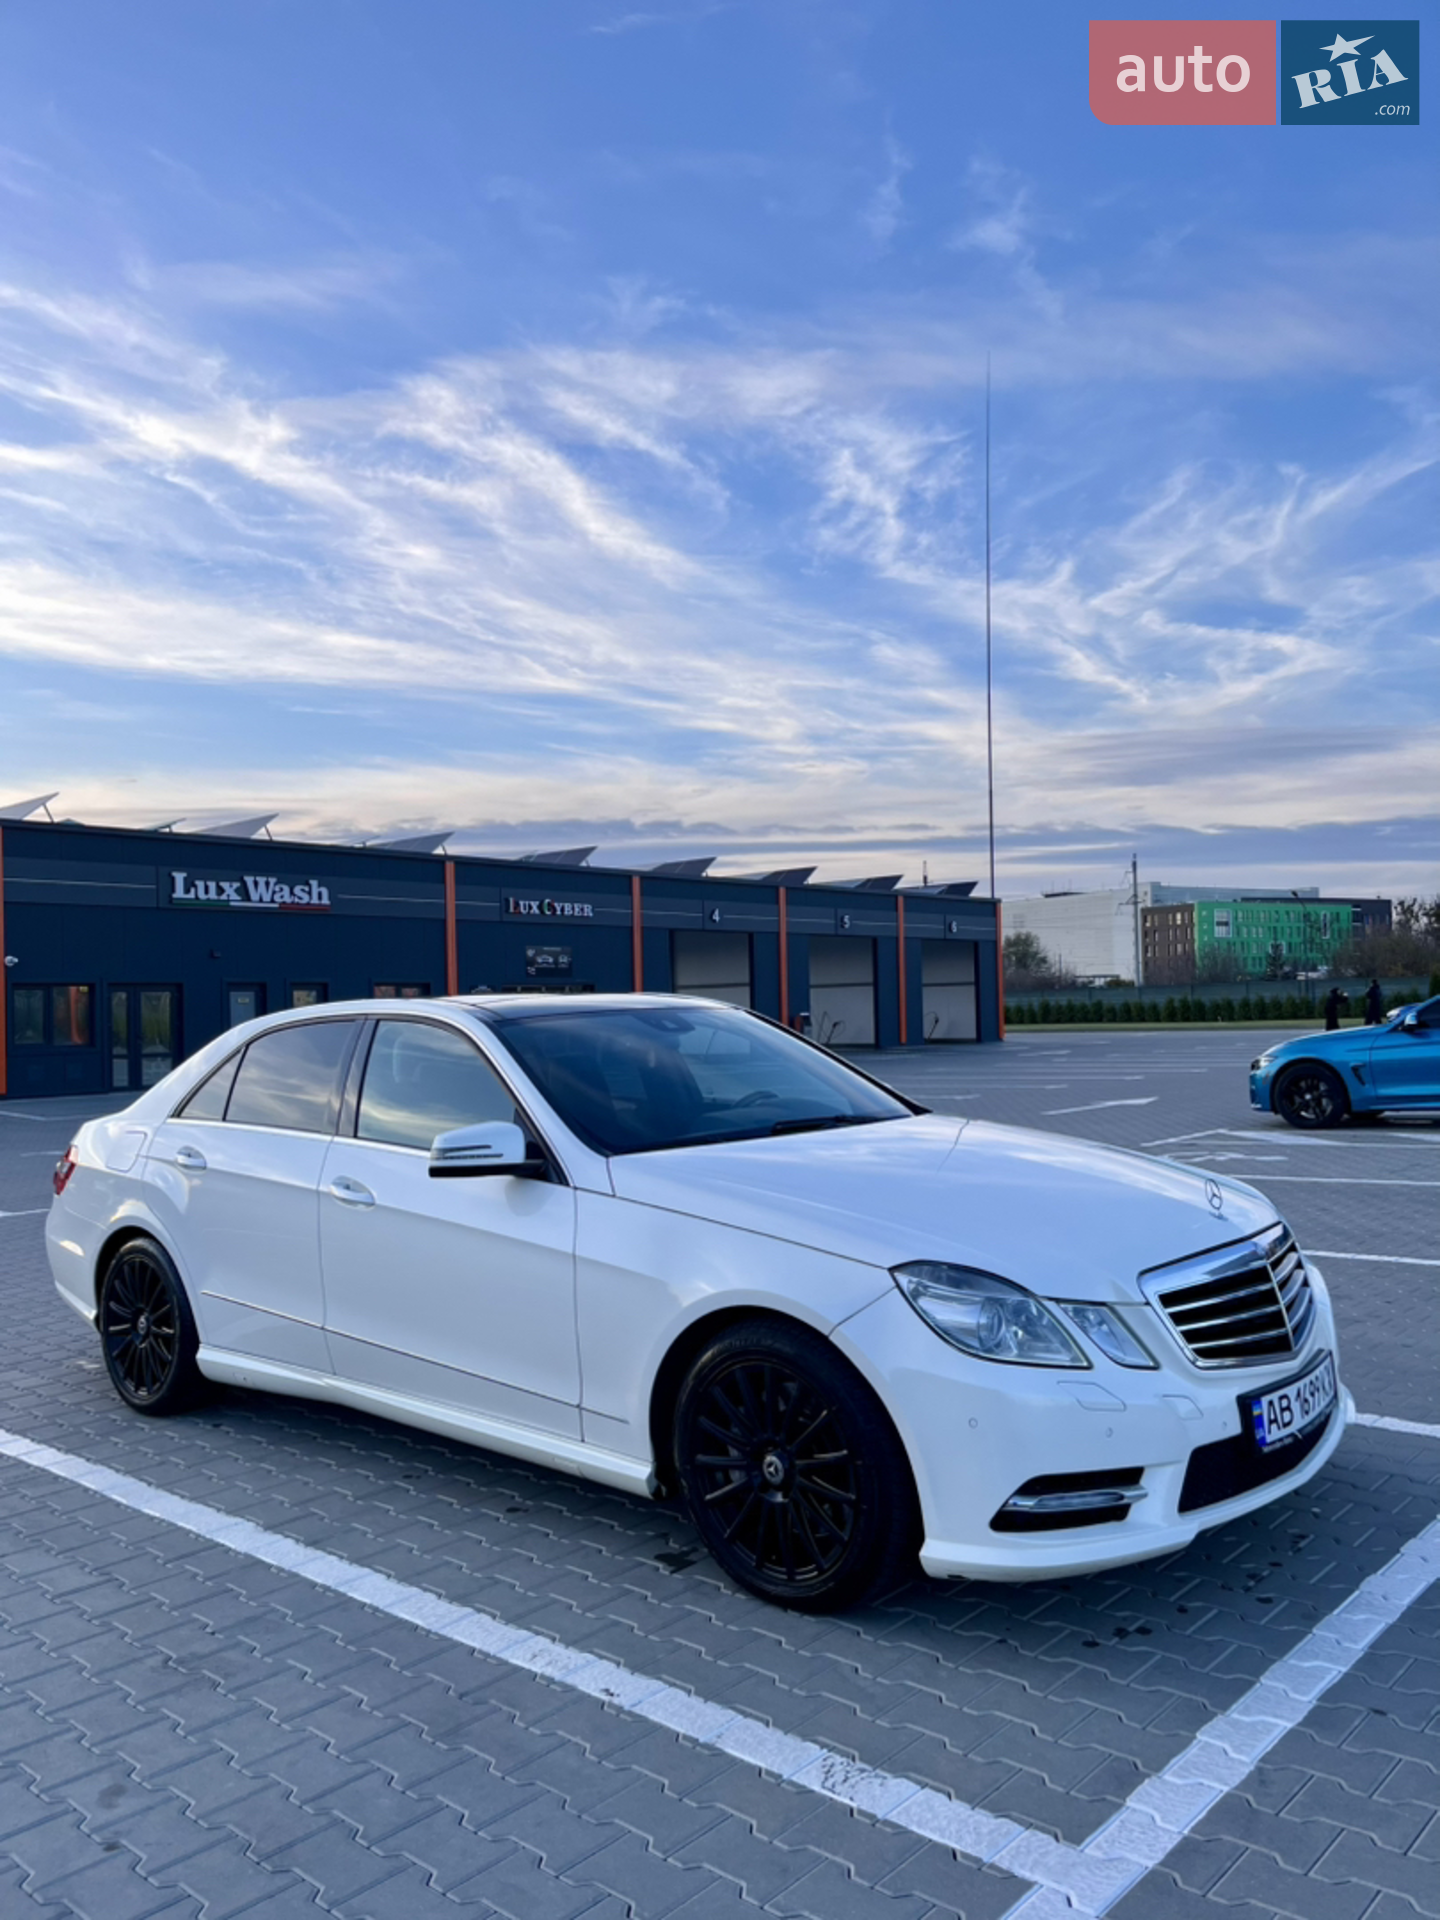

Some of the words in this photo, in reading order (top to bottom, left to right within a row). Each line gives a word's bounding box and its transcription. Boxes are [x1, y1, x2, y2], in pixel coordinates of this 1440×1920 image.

[171, 872, 241, 900] Lux
[243, 875, 330, 905] Wash
[712, 908, 721, 923] 4
[842, 915, 851, 929] 5
[1267, 1394, 1294, 1435] AB
